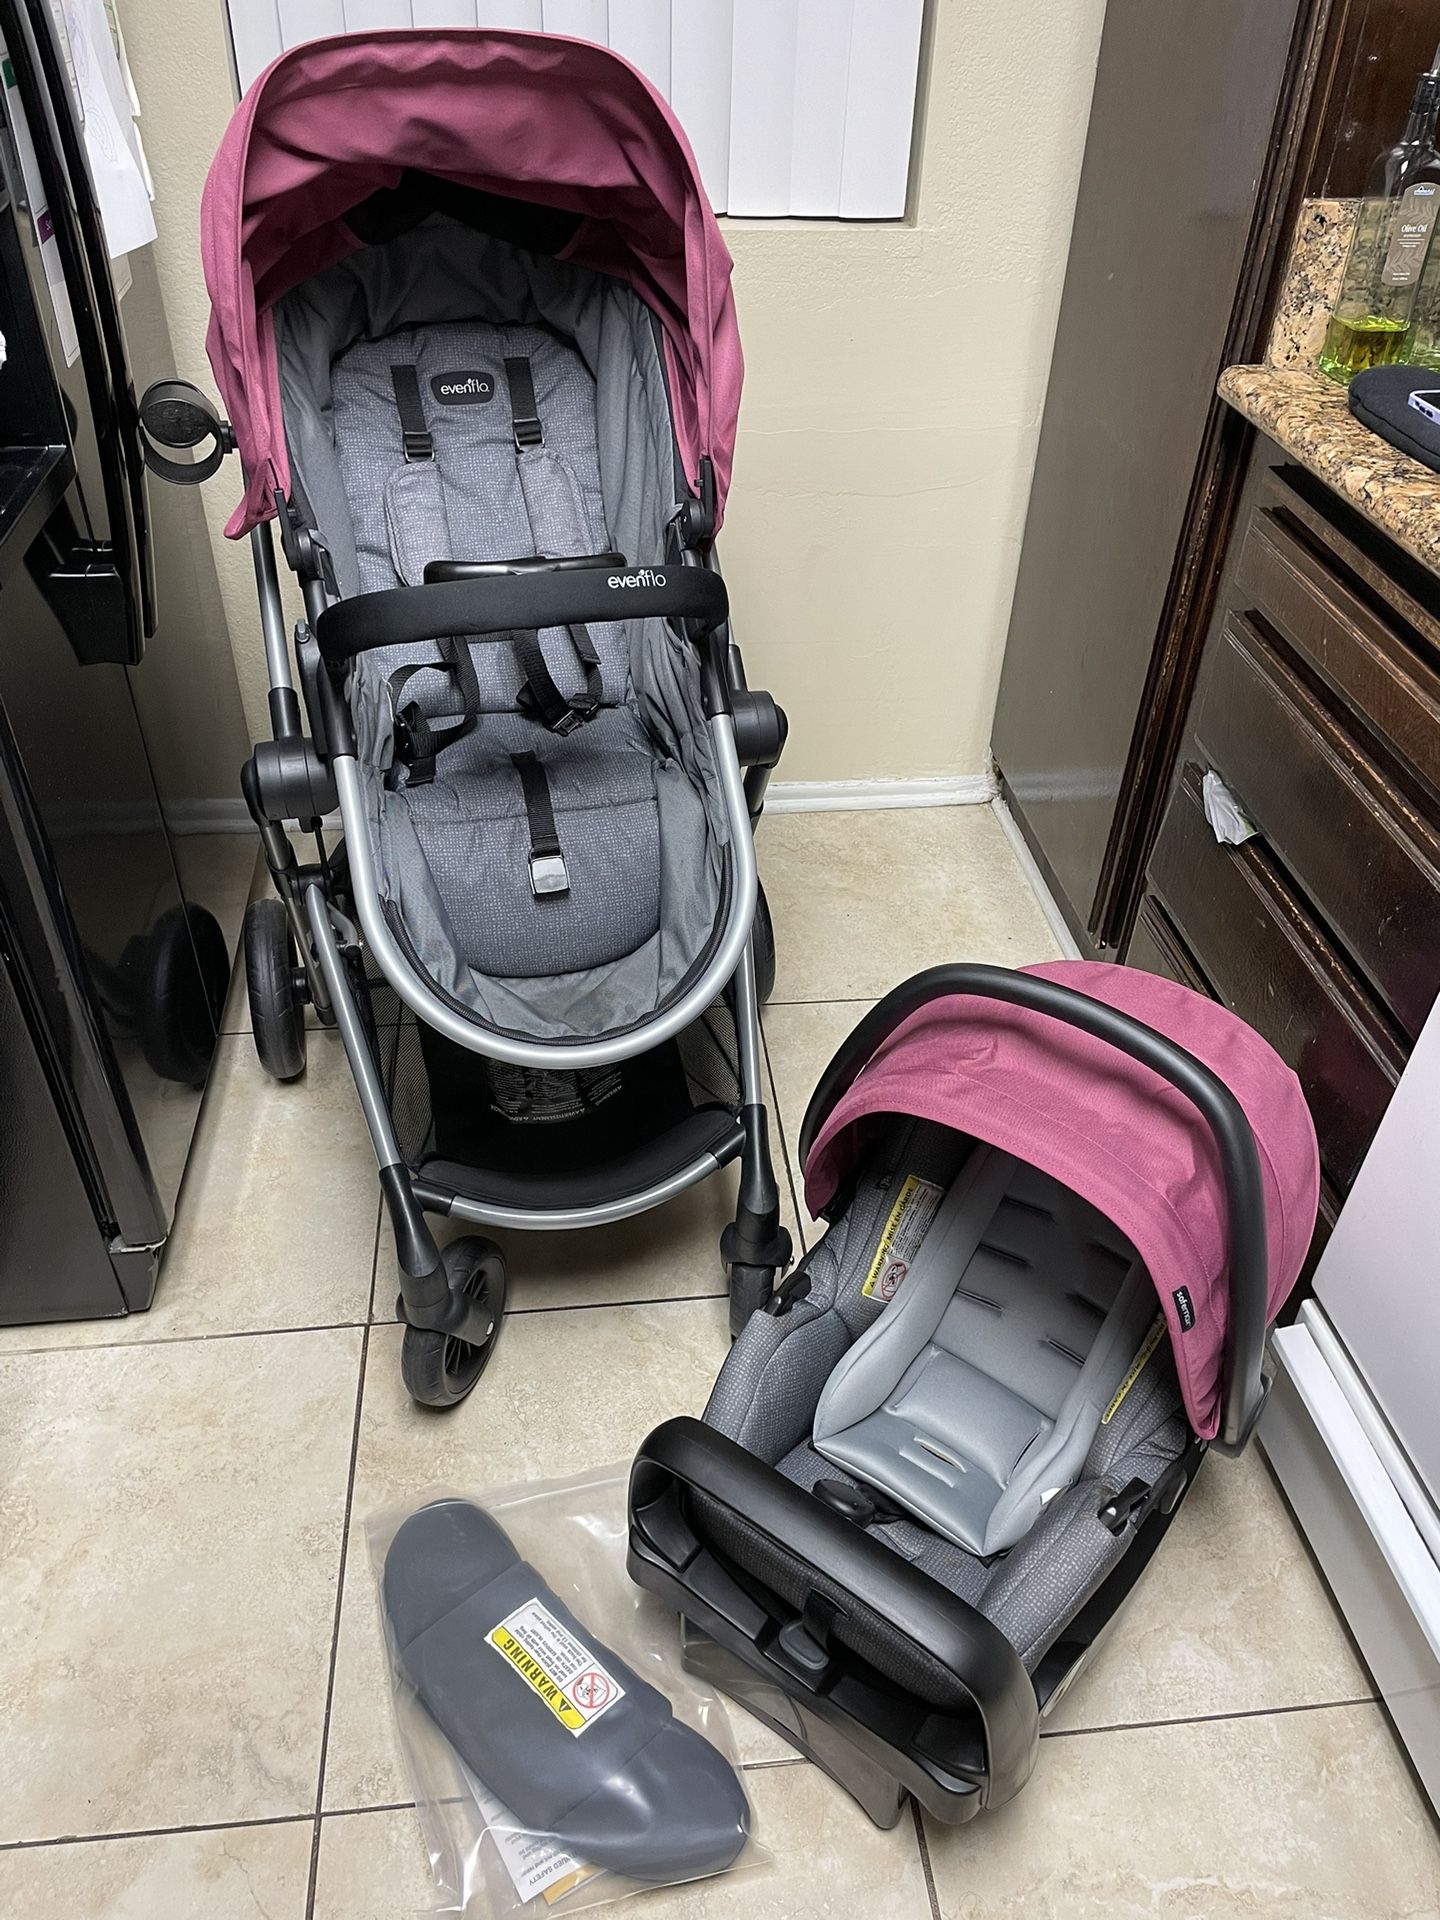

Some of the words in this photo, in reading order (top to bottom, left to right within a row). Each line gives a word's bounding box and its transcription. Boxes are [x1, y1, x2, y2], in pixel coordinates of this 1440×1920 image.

[440, 378, 490, 395] evenflo
[607, 569, 667, 589] evenflo
[501, 1637, 559, 1700] WARNING
[527, 1865, 554, 1886] SAFETY
